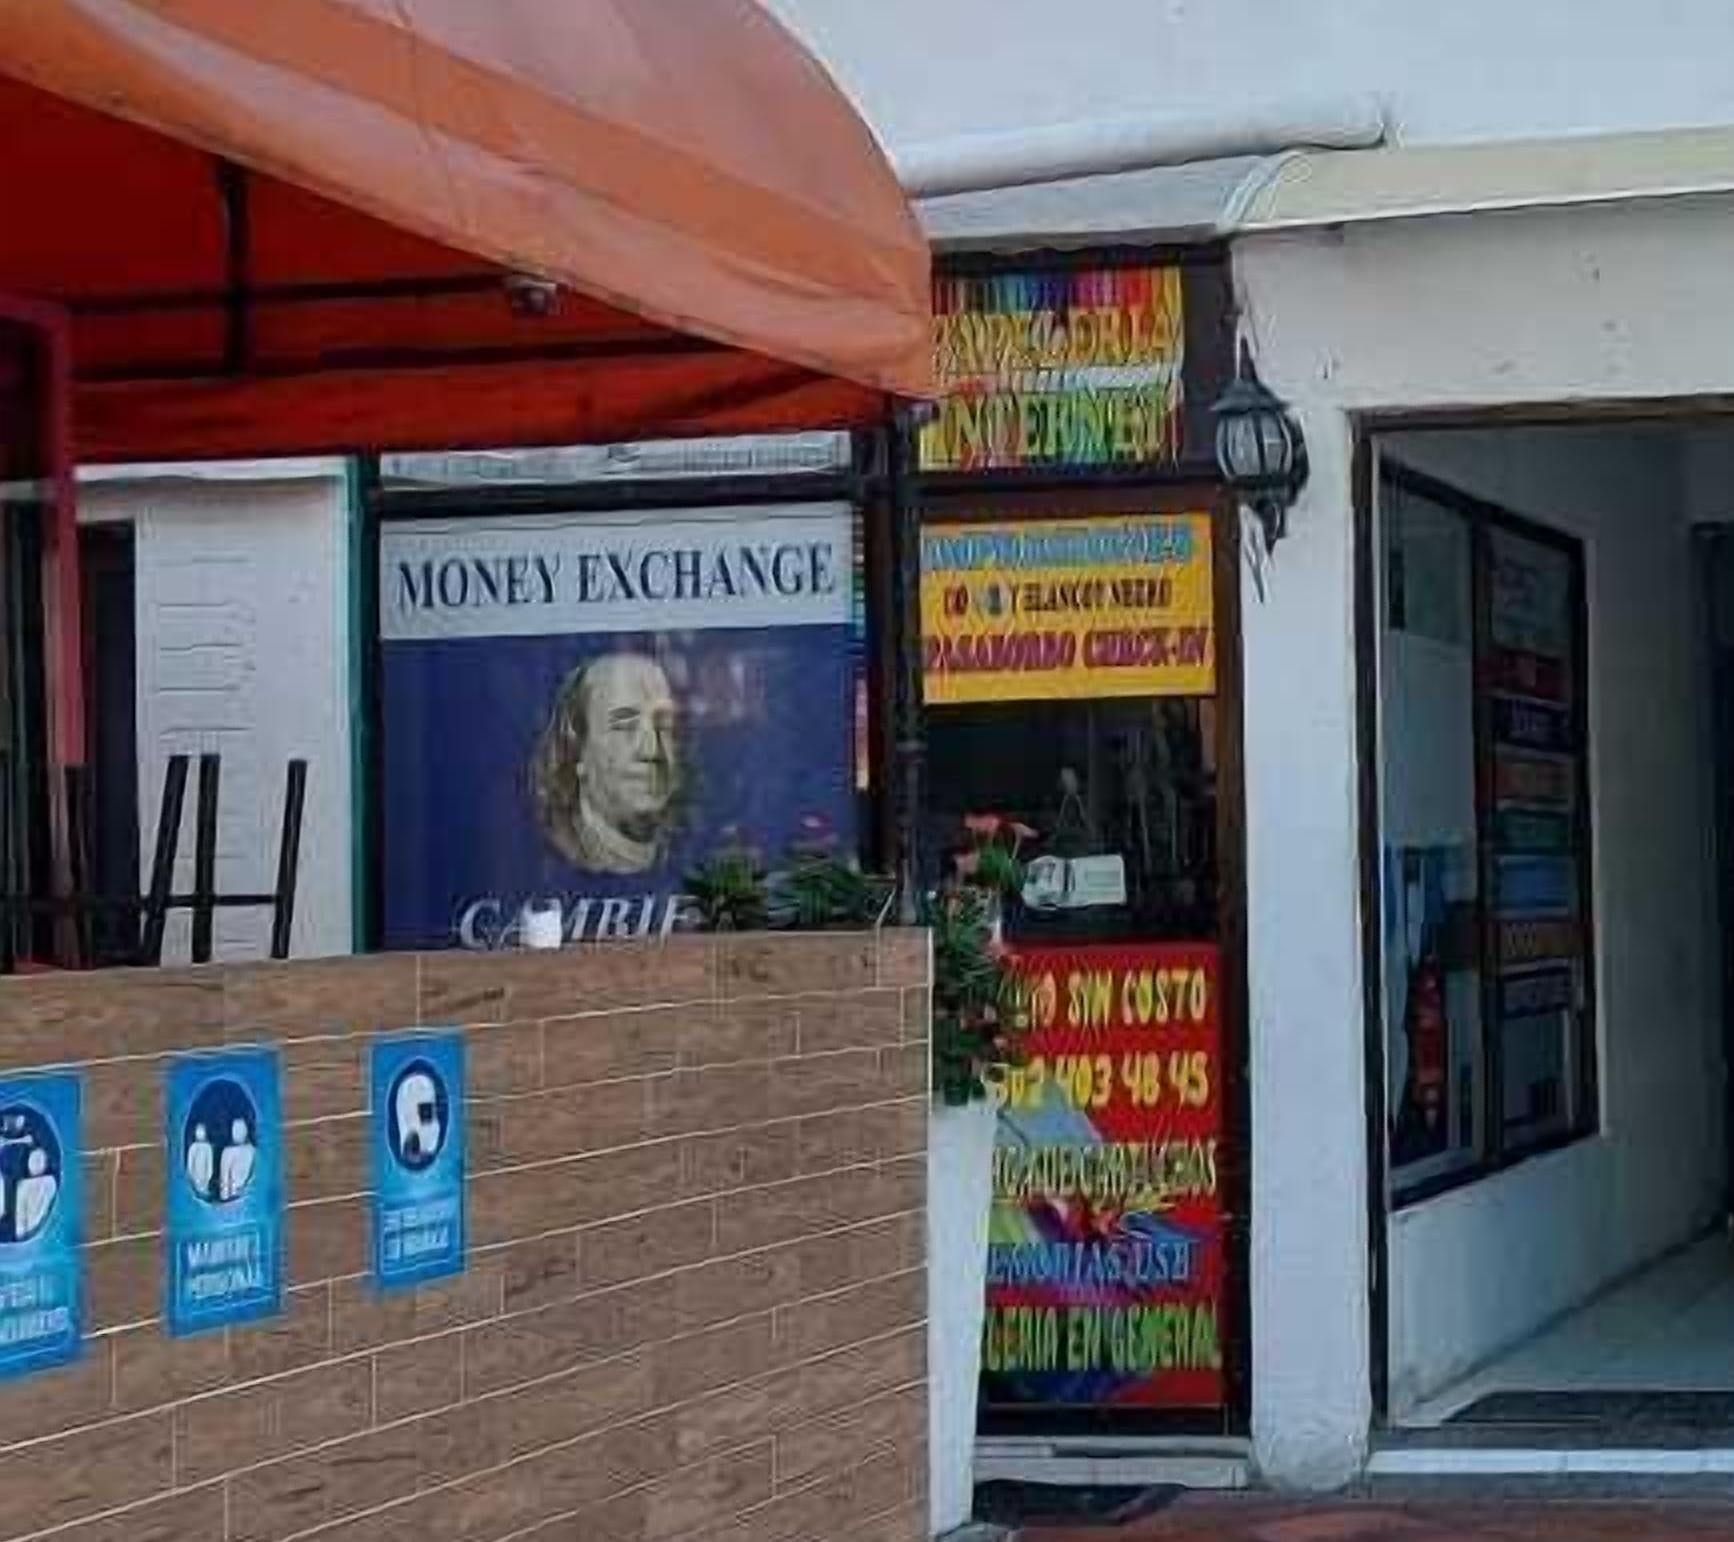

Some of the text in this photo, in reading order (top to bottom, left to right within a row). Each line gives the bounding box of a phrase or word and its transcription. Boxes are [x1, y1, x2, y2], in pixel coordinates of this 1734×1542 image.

[400, 543, 834, 611] MONEY EXCHANGE
[1055, 1053, 1112, 1109] 403
[1121, 1051, 1161, 1109] 48
[1169, 1050, 1209, 1110] 45
